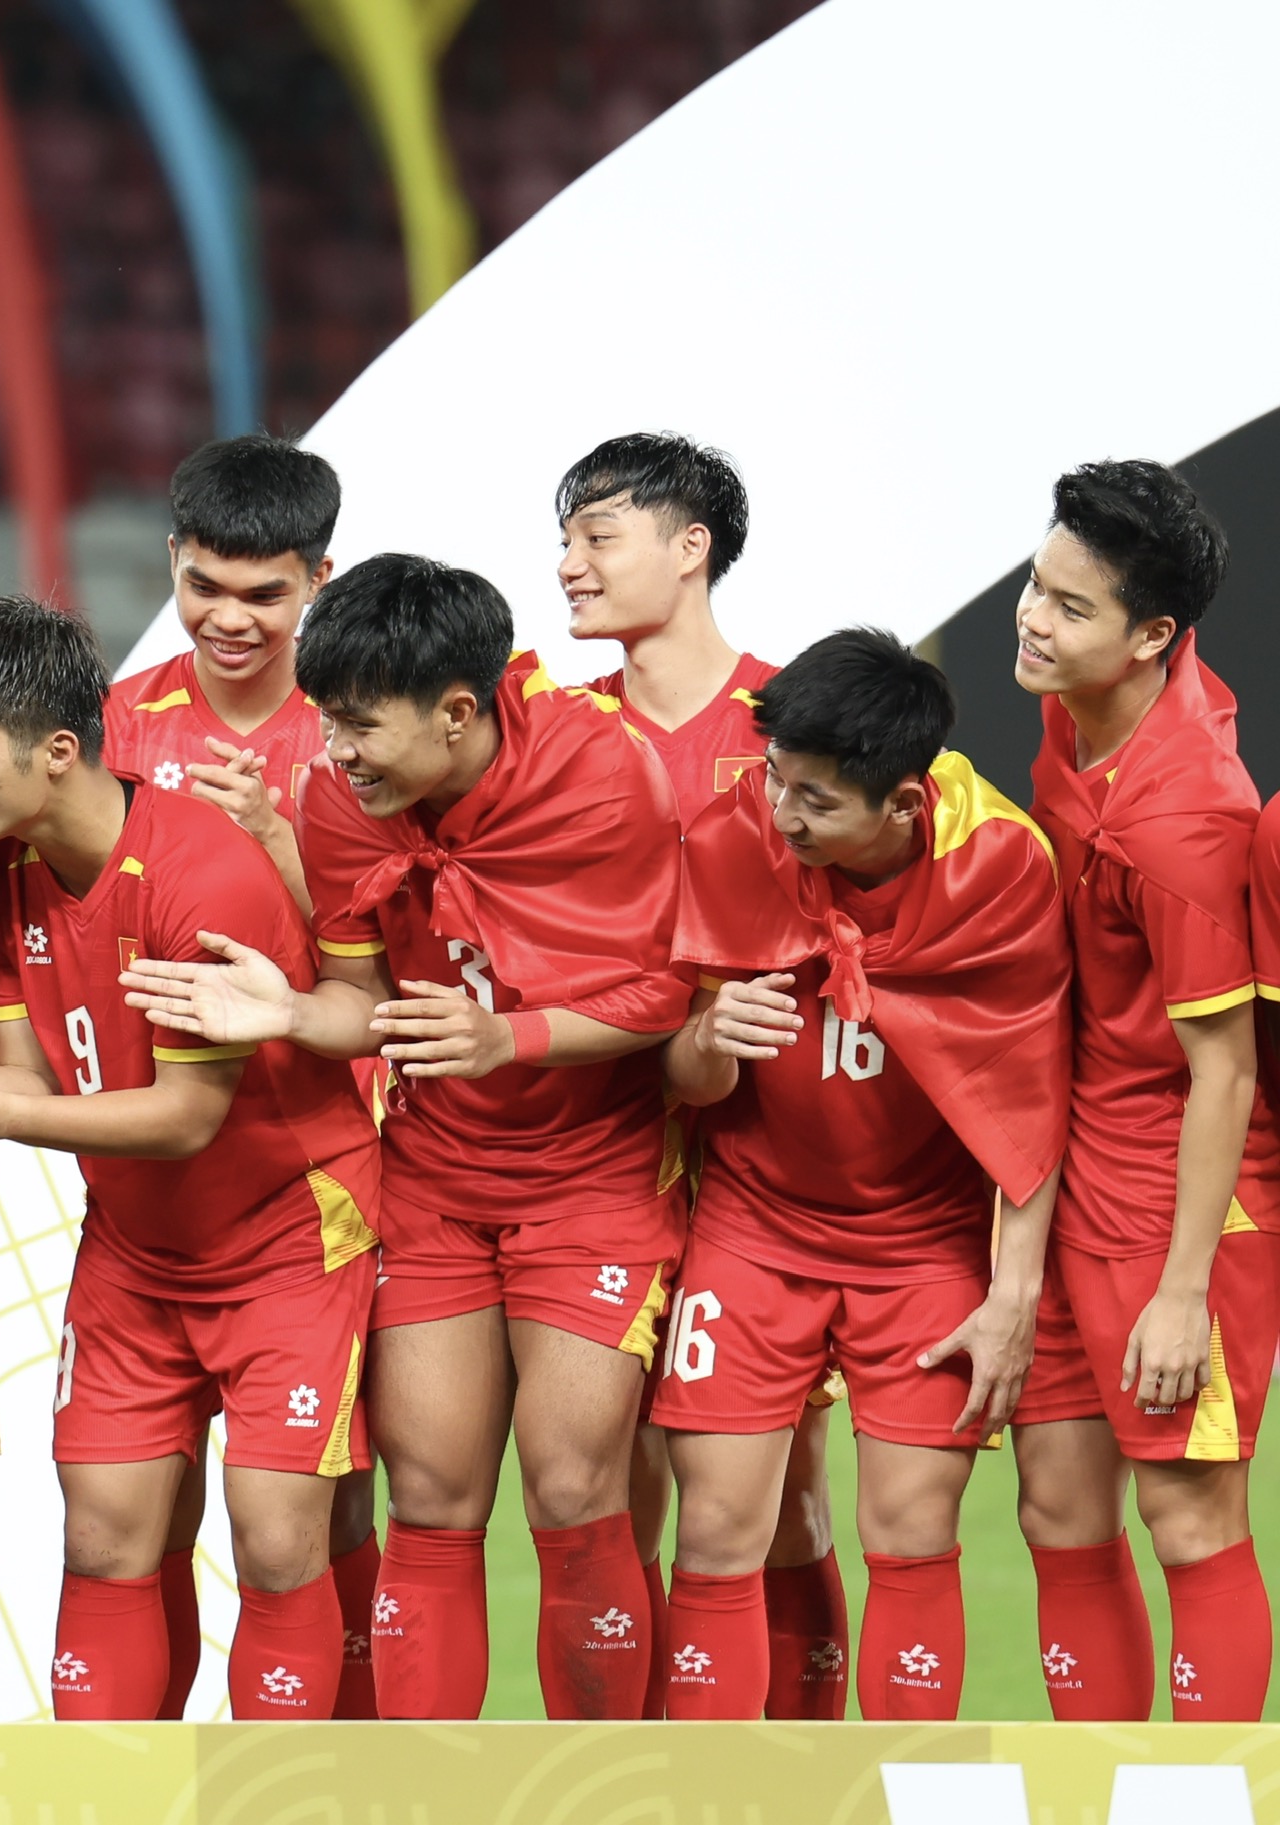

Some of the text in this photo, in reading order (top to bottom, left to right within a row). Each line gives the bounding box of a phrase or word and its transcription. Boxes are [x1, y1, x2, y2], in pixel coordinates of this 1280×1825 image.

[447, 938, 495, 1013] 3
[64, 1004, 104, 1097] 9
[820, 996, 886, 1082] 16
[662, 1287, 723, 1384] 16
